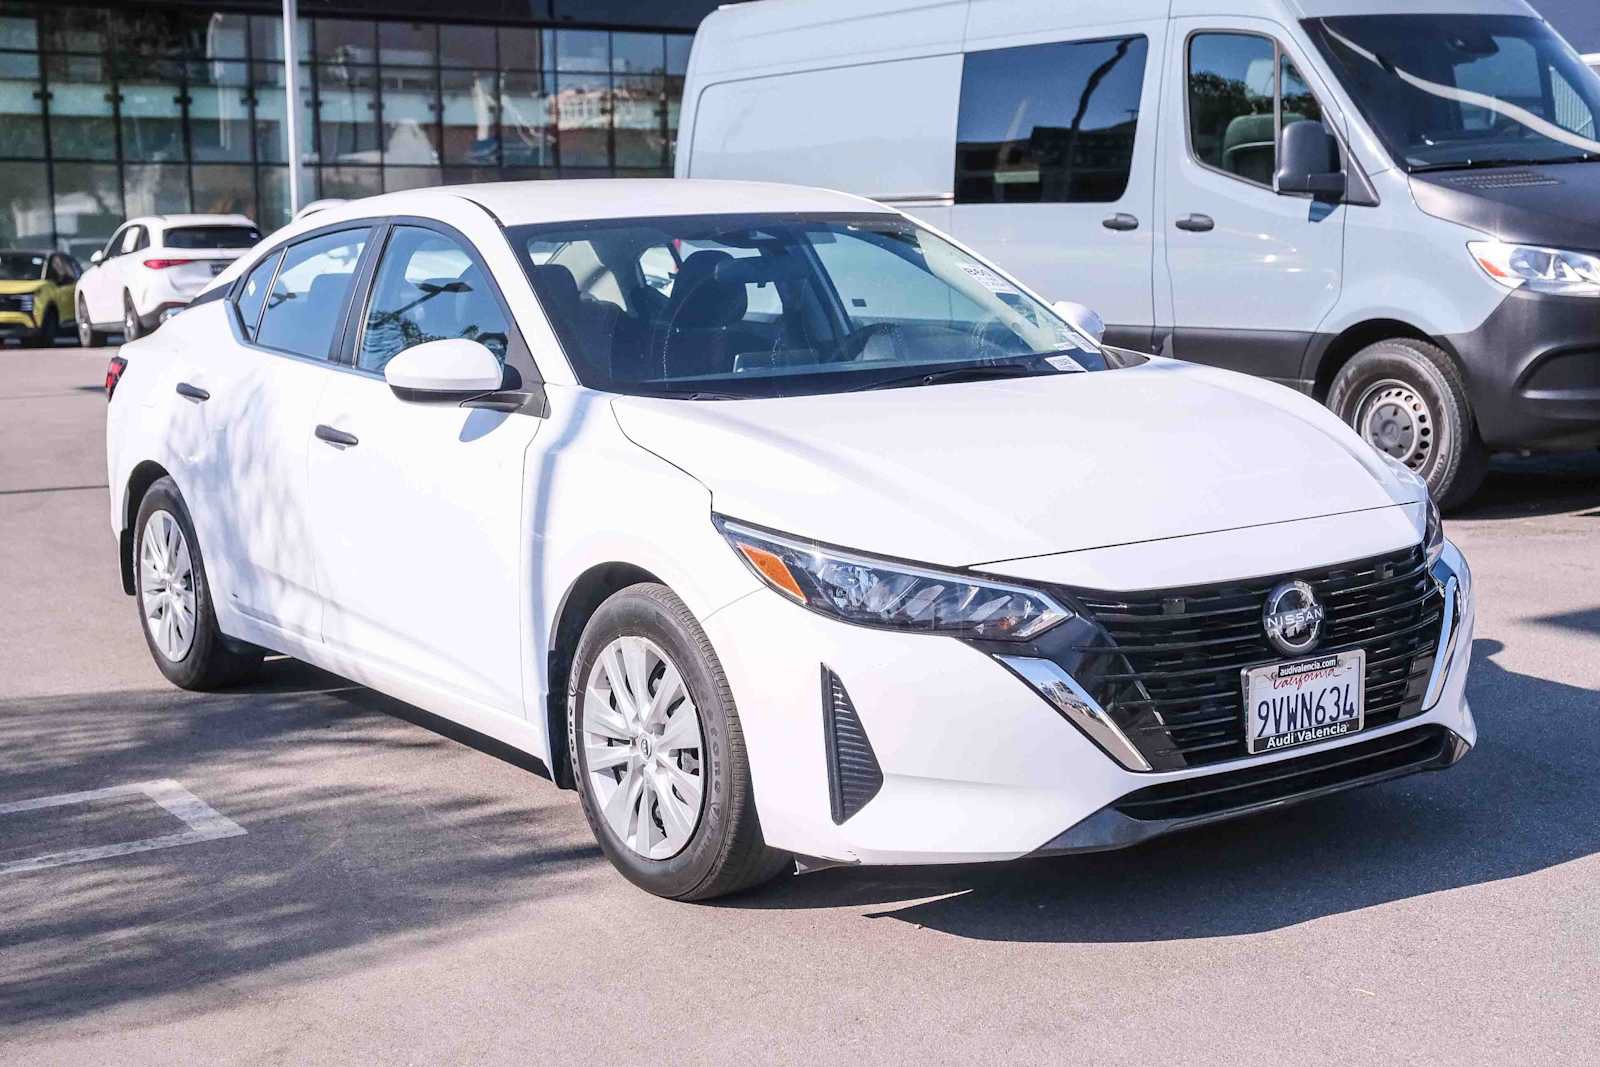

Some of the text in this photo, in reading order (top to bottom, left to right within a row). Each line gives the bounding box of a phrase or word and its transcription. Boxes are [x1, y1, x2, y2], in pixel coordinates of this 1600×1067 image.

[1267, 608, 1323, 628] NISSAN
[1280, 658, 1337, 676] audivalencia.com
[1257, 683, 1355, 738] 9VWN634
[1266, 722, 1348, 749] Audi Valencia
